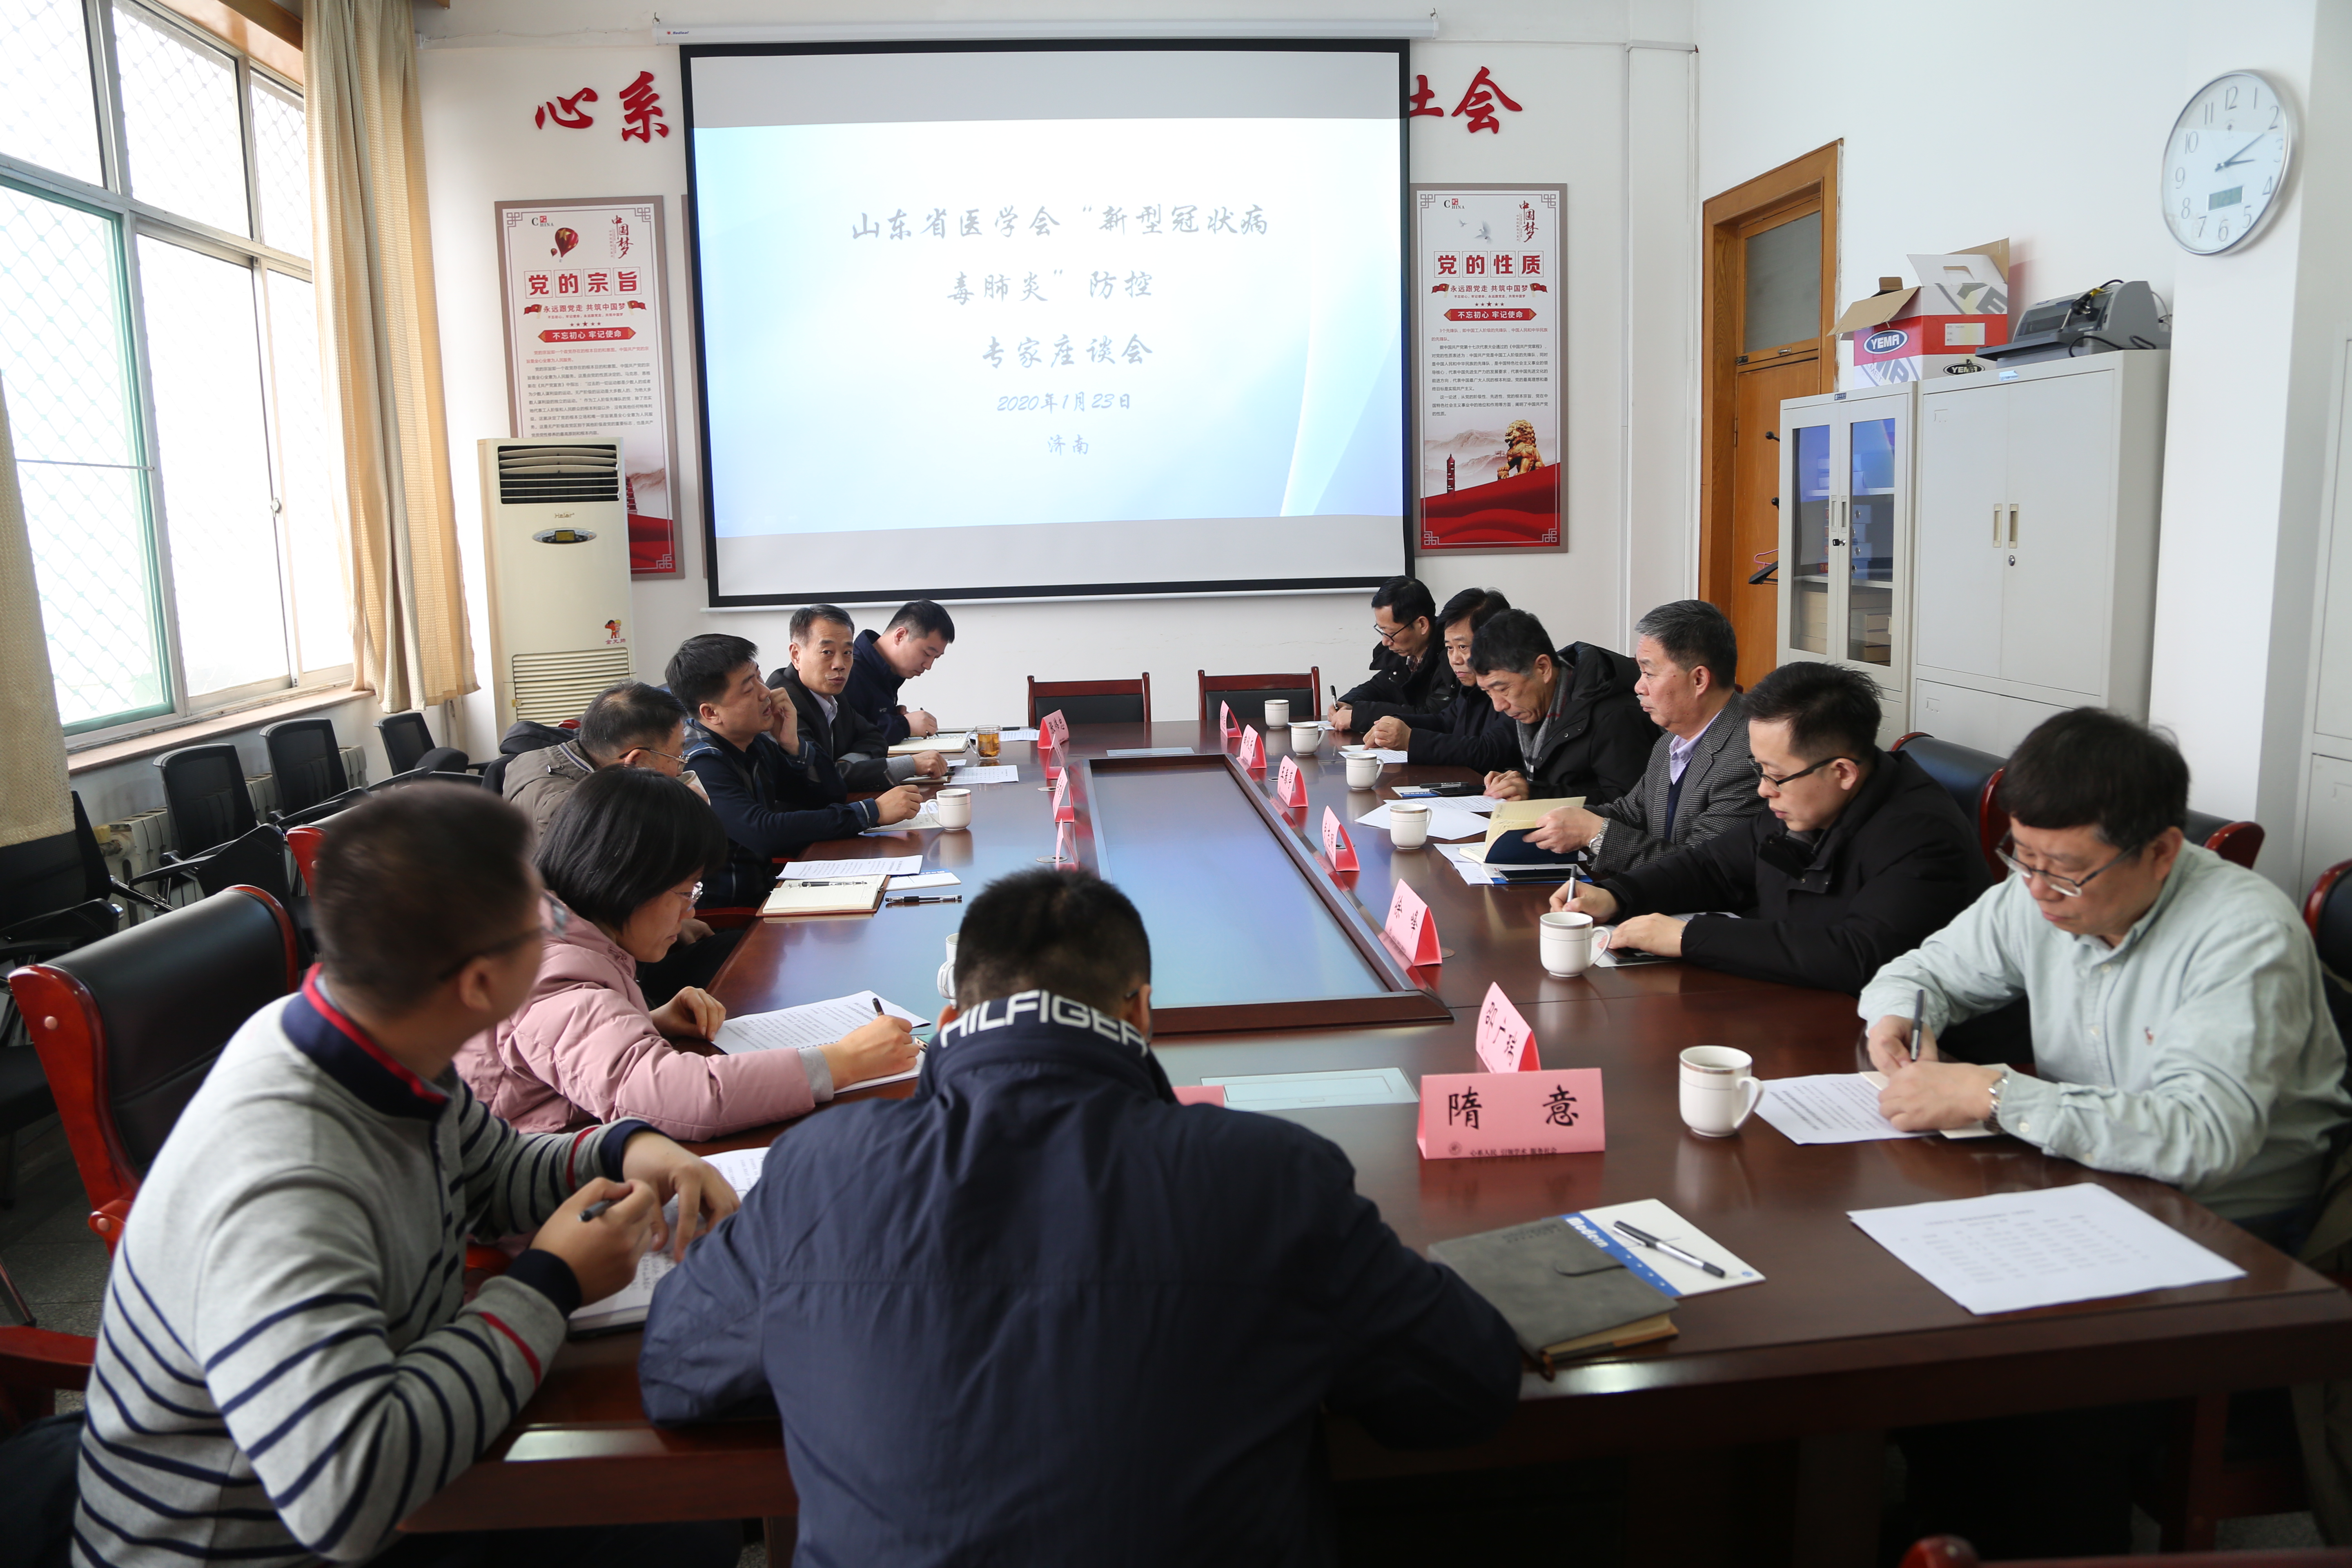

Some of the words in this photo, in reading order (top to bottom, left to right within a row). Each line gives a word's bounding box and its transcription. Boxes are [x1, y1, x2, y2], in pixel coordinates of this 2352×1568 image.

[535, 71, 669, 143] 心系
[2225, 86, 2238, 111] 12
[2253, 86, 2258, 110] 1
[2205, 102, 2214, 125] 11
[2268, 105, 2279, 130] 2
[2185, 131, 2198, 154] 10
[2175, 167, 2185, 189] 9
[2262, 176, 2273, 196] 4
[1444, 200, 1465, 209] CHINA
[2181, 198, 2190, 219] 8
[532, 217, 554, 227] CHINA
[1519, 200, 1539, 243] 中国梦
[2198, 216, 2207, 238] 7
[2243, 205, 2252, 229] 5
[611, 215, 634, 259] 中国梦
[2218, 219, 2229, 242] 6
[1438, 254, 1541, 275] 党的性质
[528, 271, 638, 296] 党的宗旨
[543, 304, 584, 312] 永远跟党走
[586, 303, 626, 312] 共筑中国梦
[552, 331, 586, 340] 不忘初心
[588, 330, 622, 339] 牢记使命
[1871, 334, 1900, 350] YEMA
[982, 333, 1154, 369] 专家座谈会
[997, 391, 1132, 413] 2020年1月23日
[1047, 434, 1090, 456] 济南
[1565, 1216, 1609, 1249] Modern
